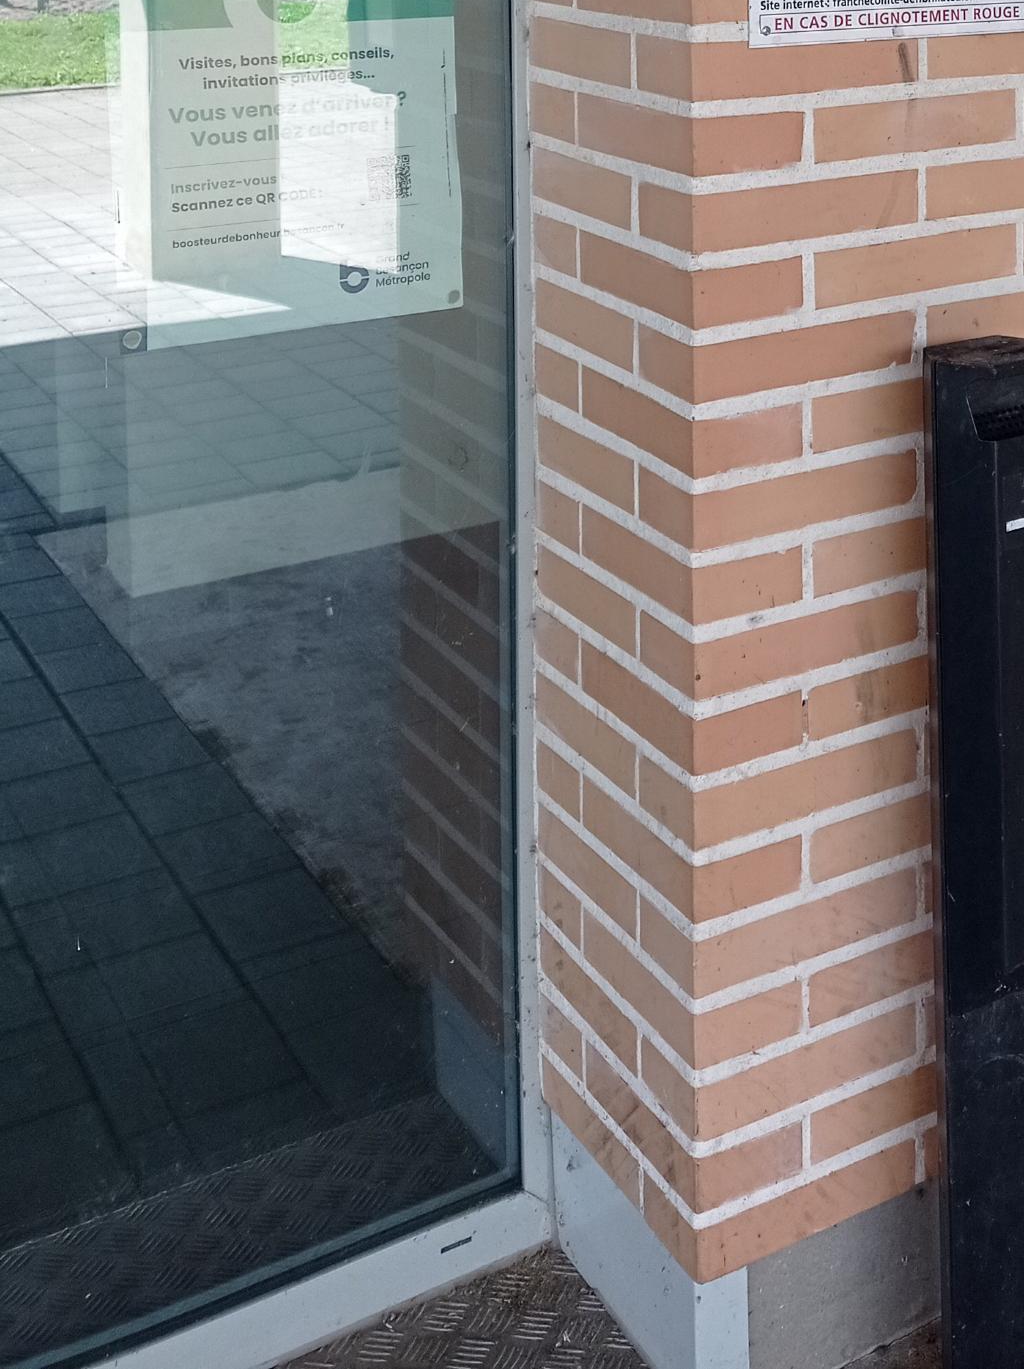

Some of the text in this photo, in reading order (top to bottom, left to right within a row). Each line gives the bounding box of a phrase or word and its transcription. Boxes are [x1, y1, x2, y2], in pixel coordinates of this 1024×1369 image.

[760, 0, 780, 10] Site
[775, 17, 794, 30] EN
[799, 15, 828, 29] CAS
[834, 14, 852, 27] DE
[858, 8, 969, 26] CLIGNOTEMENT
[973, 5, 1020, 19] ROUGE
[179, 47, 394, 70] Visites, bons plans, conseils,
[203, 73, 285, 90] invitations
[168, 107, 226, 124] Vous
[231, 102, 296, 119] venez
[397, 91, 407, 106] ?
[190, 129, 248, 147] Vous
[253, 123, 305, 142] allez
[171, 175, 277, 194] Inscrivez-vous
[171, 199, 232, 213] Scannez
[236, 196, 253, 206] ce
[256, 192, 276, 205] QR
[375, 271, 431, 287] Métropole
